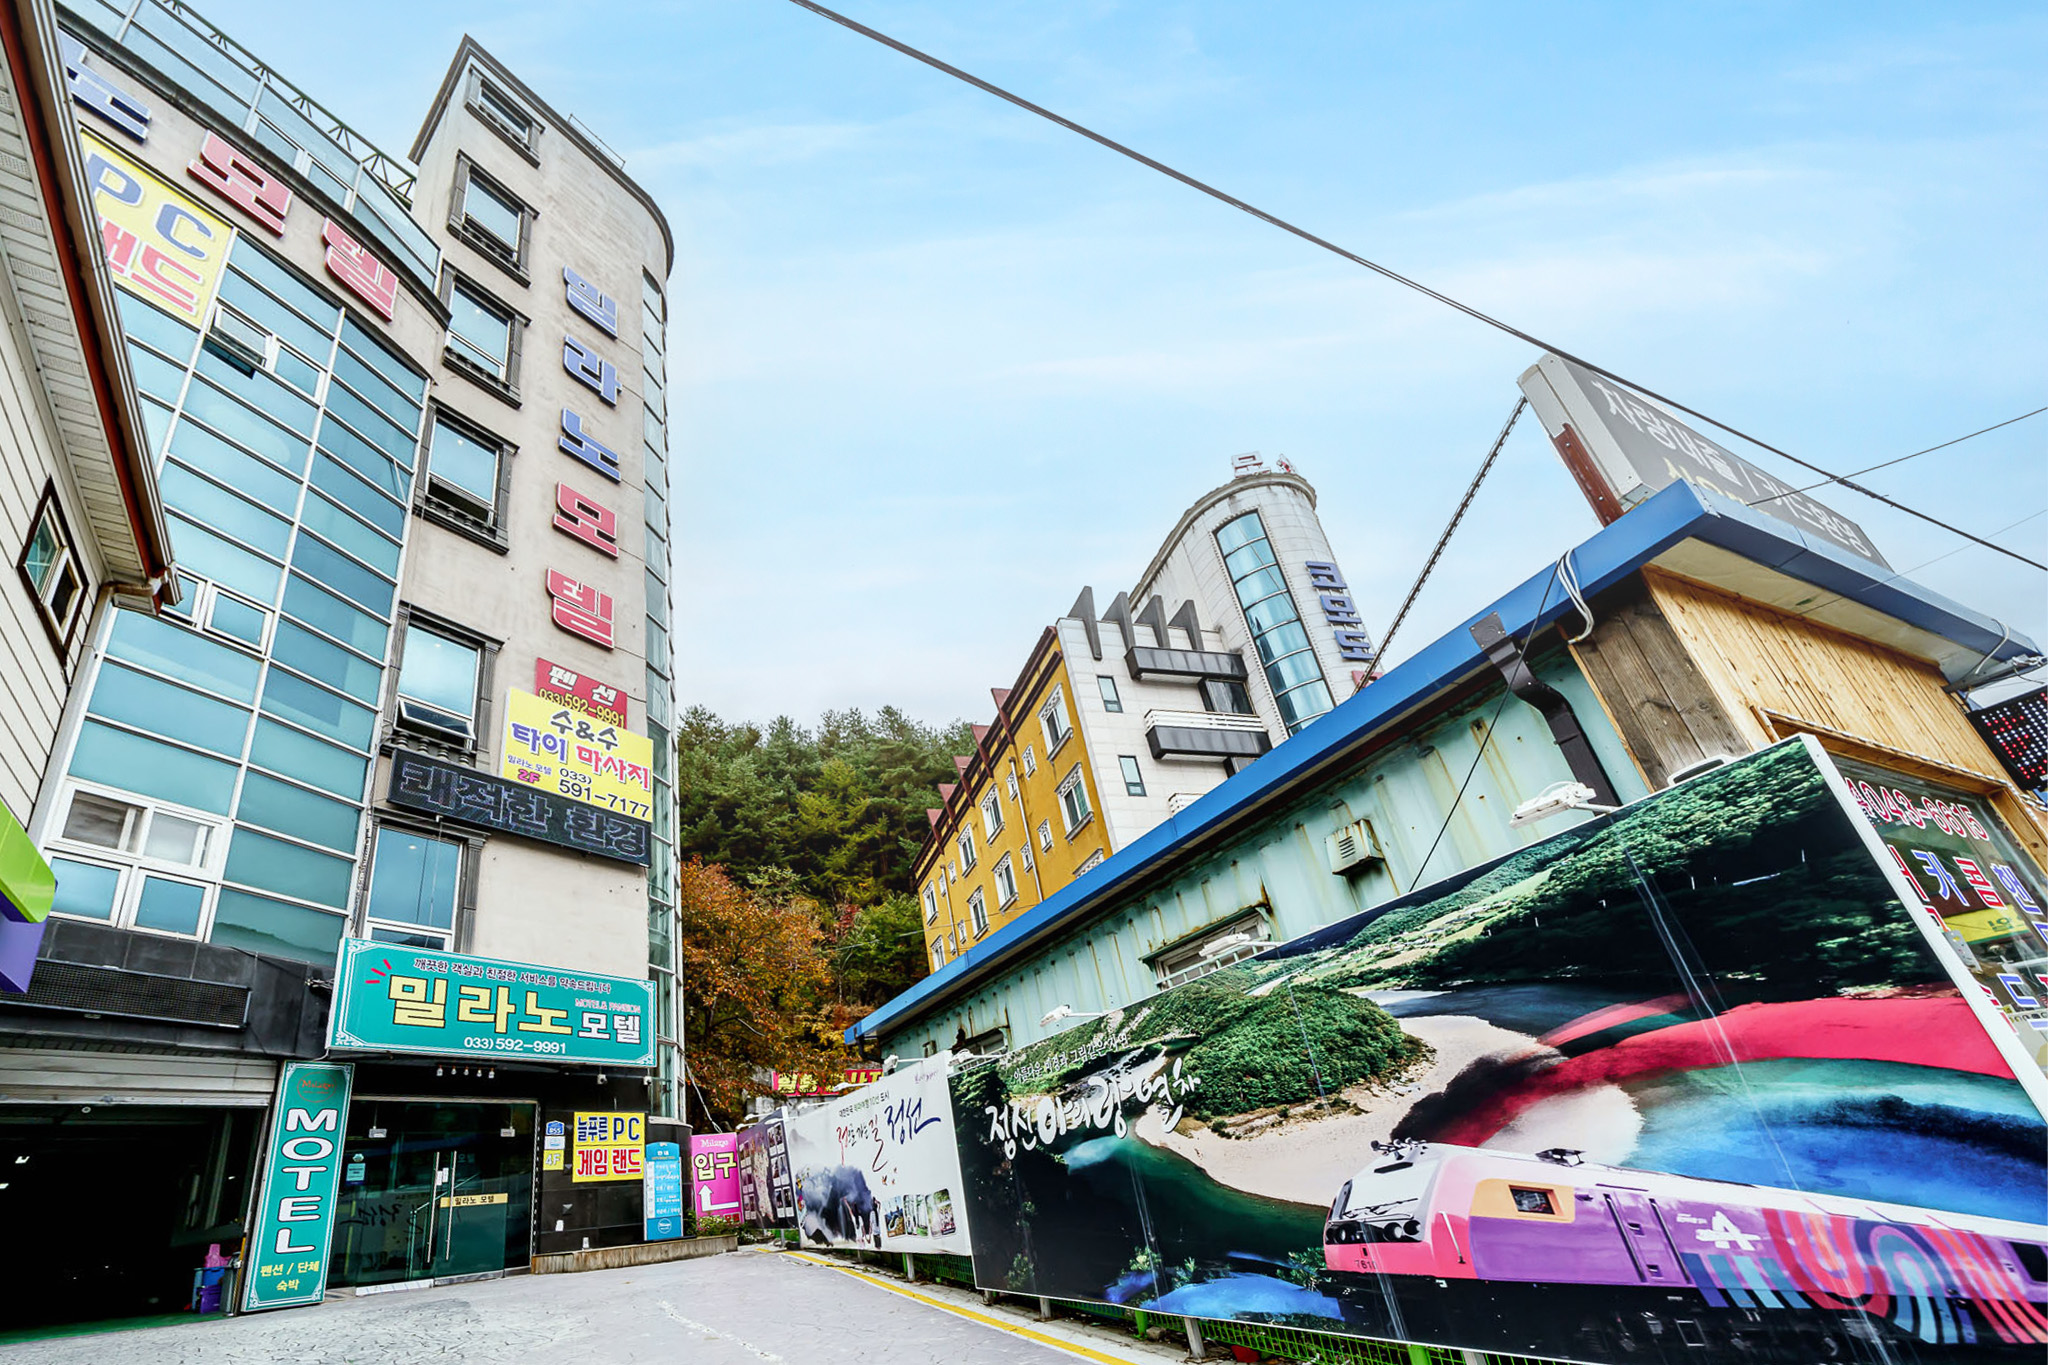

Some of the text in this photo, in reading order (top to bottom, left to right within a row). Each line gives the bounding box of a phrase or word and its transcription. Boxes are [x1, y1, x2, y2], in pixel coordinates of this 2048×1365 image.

[86, 151, 216, 260] PC
[186, 129, 400, 322] 모텔
[1590, 379, 1743, 487] 차량대출
[545, 264, 623, 651] 밀라노 모텔
[550, 710, 619, 751] 수&수
[511, 723, 651, 792] 타이 마사지
[517, 768, 541, 784] 2F
[559, 767, 593, 785] 033)
[558, 779, 650, 818] 591-7177
[564, 805, 646, 858] 환경
[413, 957, 449, 974] 깨끗한
[451, 962, 484, 978] 객실과
[486, 967, 517, 983] 친절한
[519, 971, 557, 988] 서비스를
[388, 974, 573, 1036] 밀라노
[577, 1011, 641, 1045] 모텔
[613, 1117, 640, 1142] PC
[545, 1153, 562, 1166] 4F
[694, 1151, 738, 1182] 입구
[274, 1107, 339, 1255] MOTEL
[275, 1278, 301, 1293] 숙박
[297, 1260, 321, 1274] 단체
